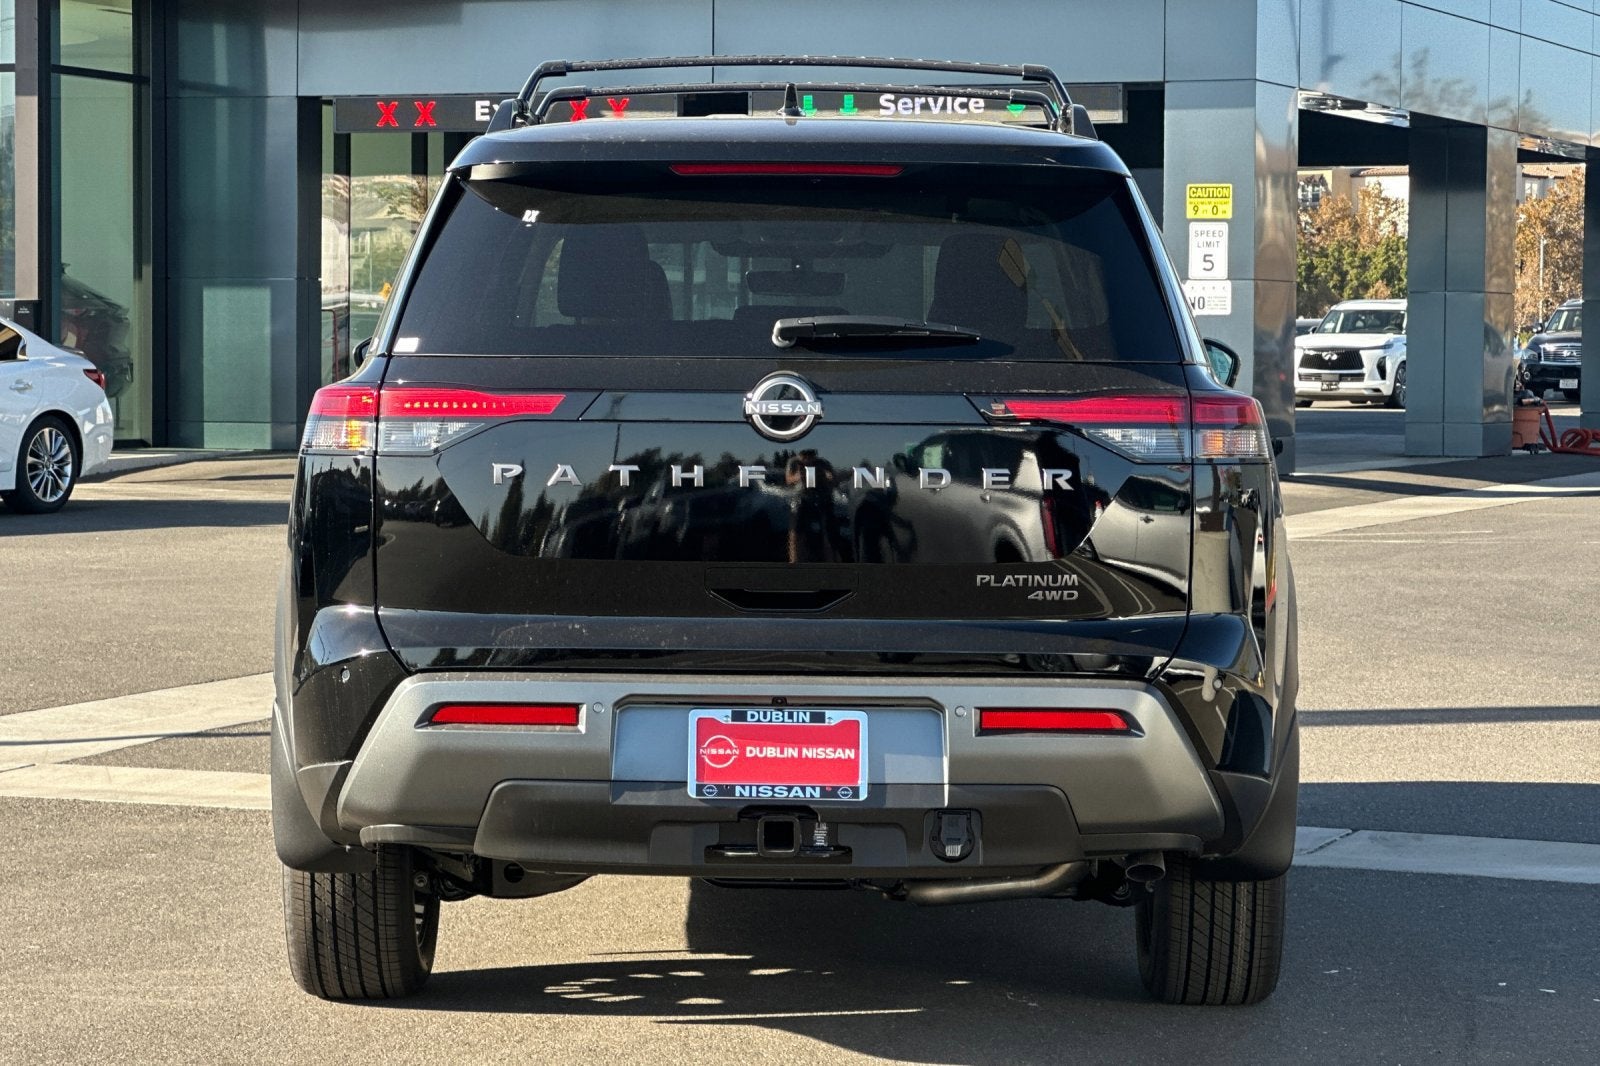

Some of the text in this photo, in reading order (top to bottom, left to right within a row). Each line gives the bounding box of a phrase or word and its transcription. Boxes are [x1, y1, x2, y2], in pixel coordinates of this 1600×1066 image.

[879, 93, 985, 116] Service
[1189, 187, 1230, 198] CAUTION
[1193, 205, 1199, 216] 9
[1194, 230, 1224, 238] SPEED
[1197, 240, 1220, 249] LIMIT
[1203, 253, 1215, 272] 5
[748, 403, 819, 413] NISSAN
[491, 463, 1074, 490] PATHFINDER
[976, 574, 1079, 587] PLATINUM
[1027, 590, 1079, 600] 4WD
[746, 711, 811, 723] DUBLIN
[745, 746, 855, 759] DUBLIN NISSAN
[735, 785, 821, 798] NISSAN
